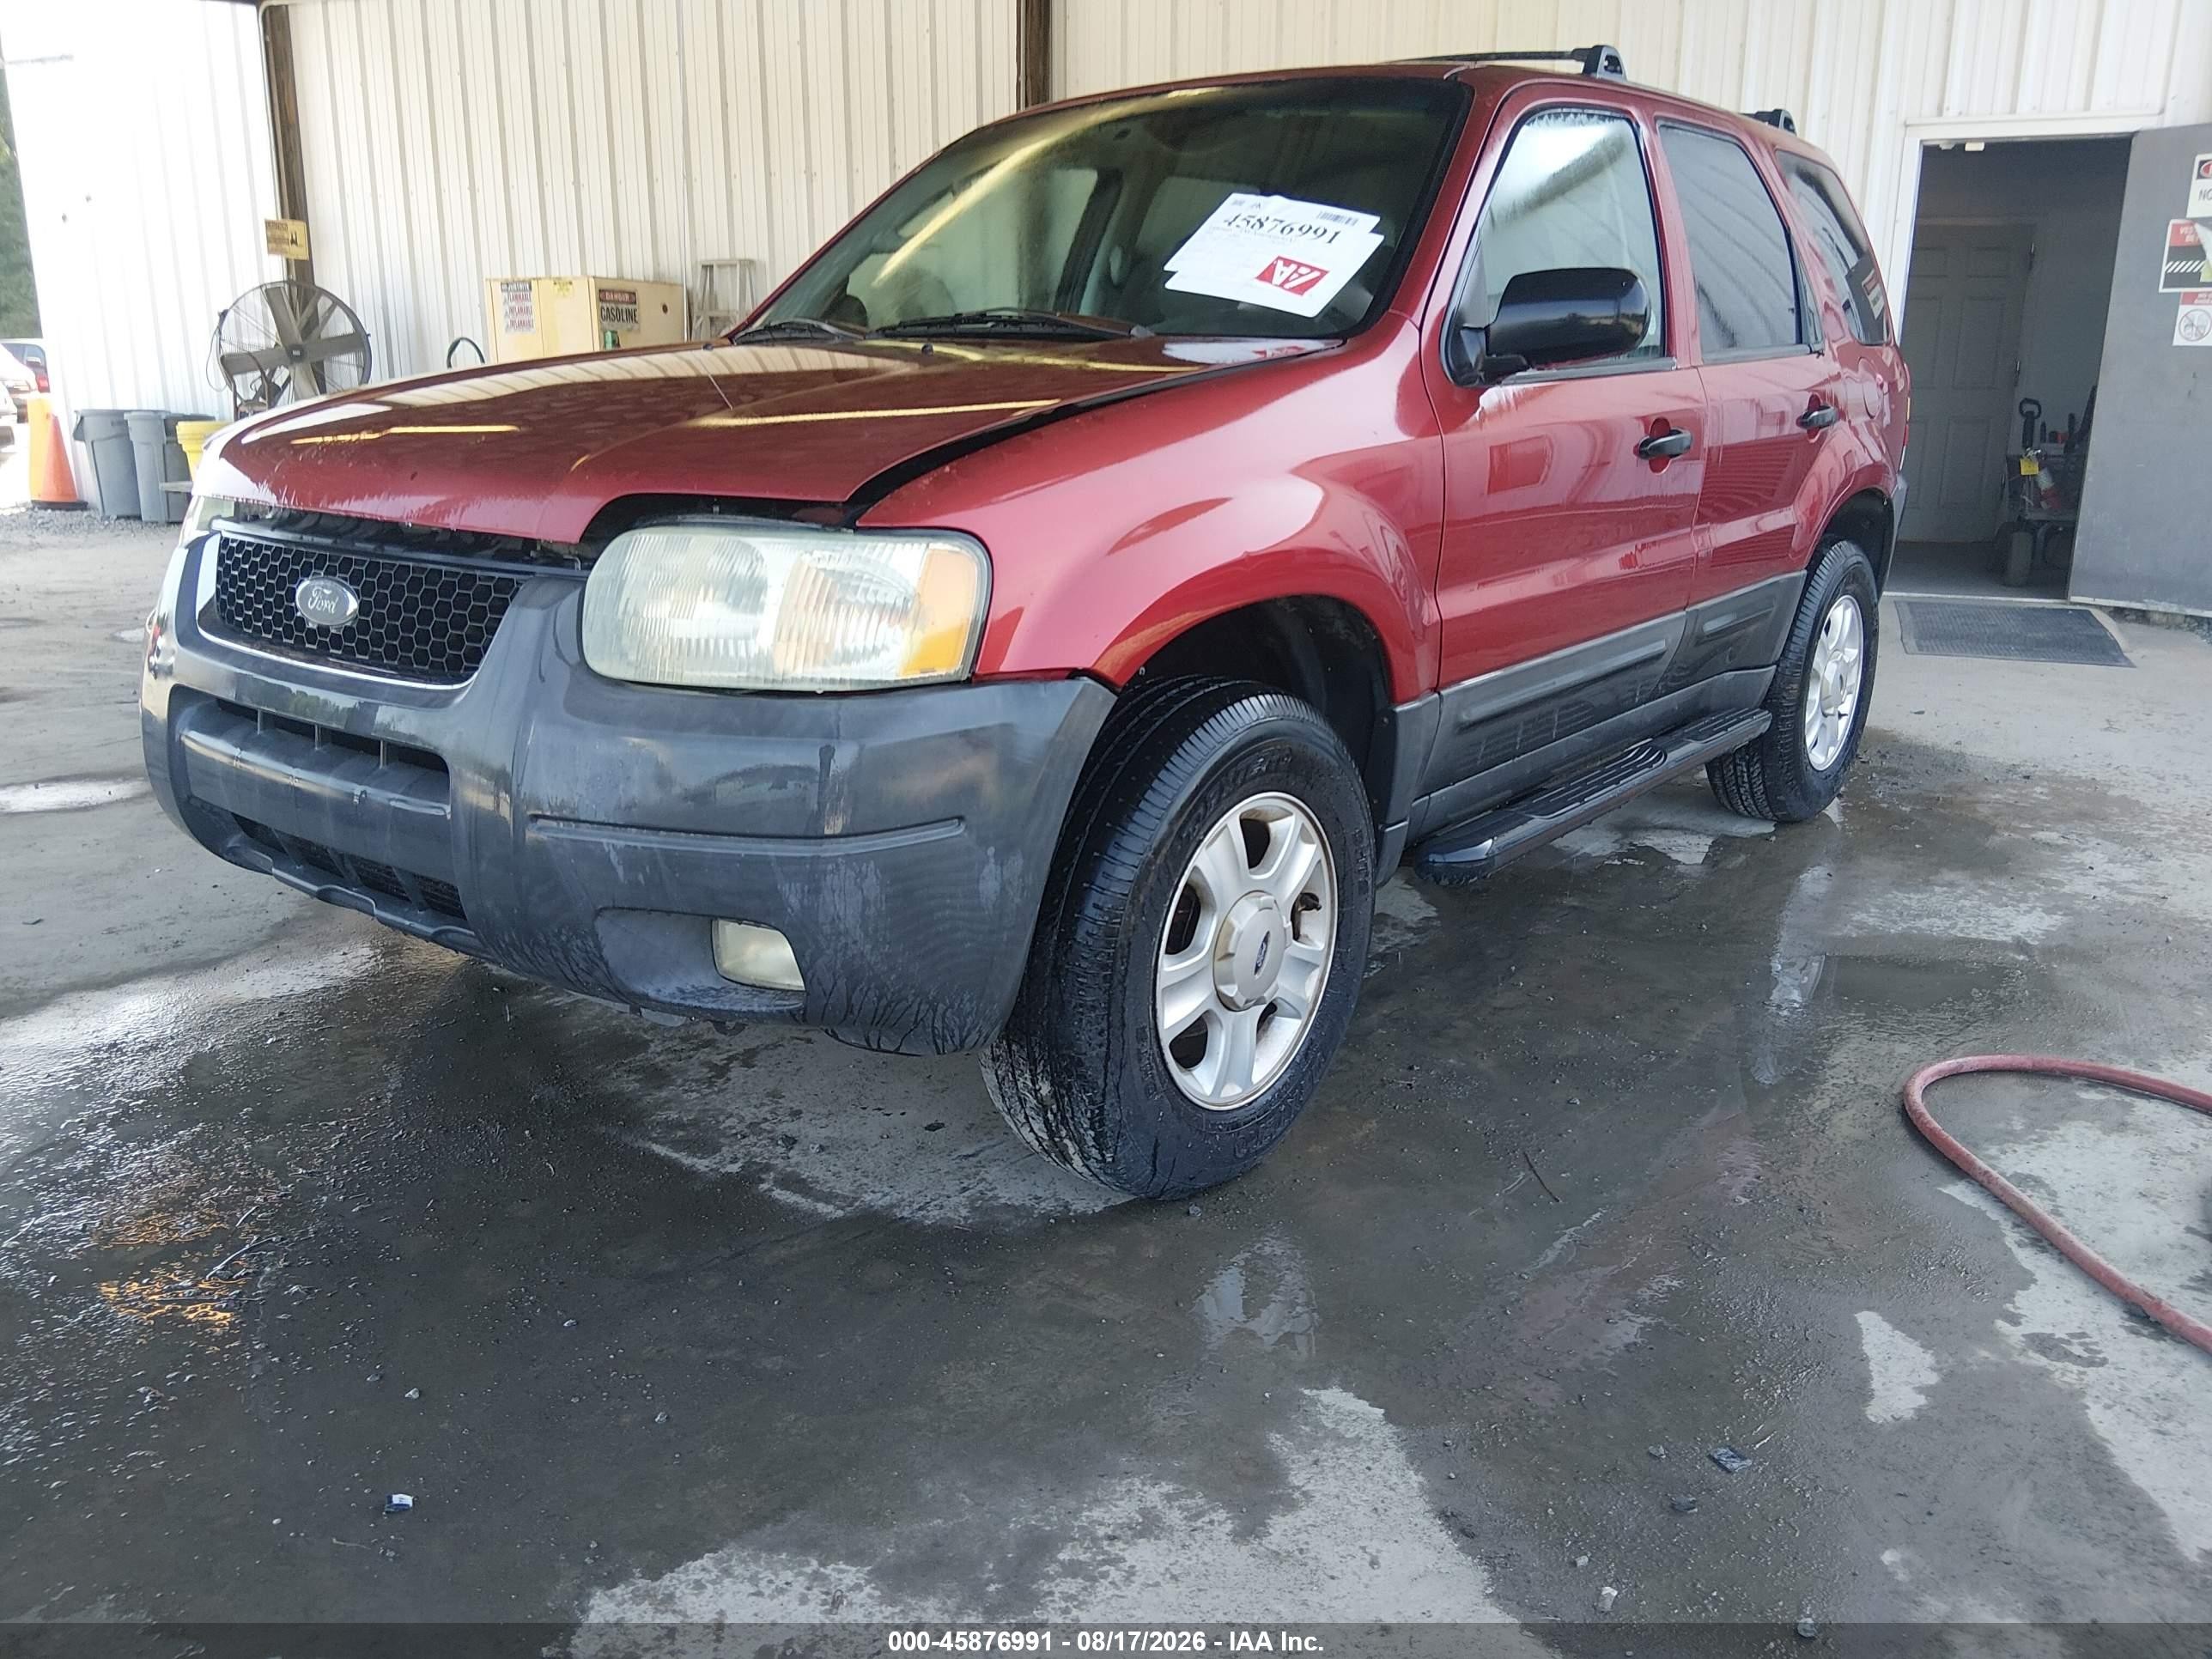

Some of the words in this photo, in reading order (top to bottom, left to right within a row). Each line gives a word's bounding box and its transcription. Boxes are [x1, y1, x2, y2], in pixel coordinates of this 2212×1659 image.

[1224, 212, 1341, 244] 45876991
[600, 306, 638, 323] GASOLINE
[307, 586, 338, 614] Ford
